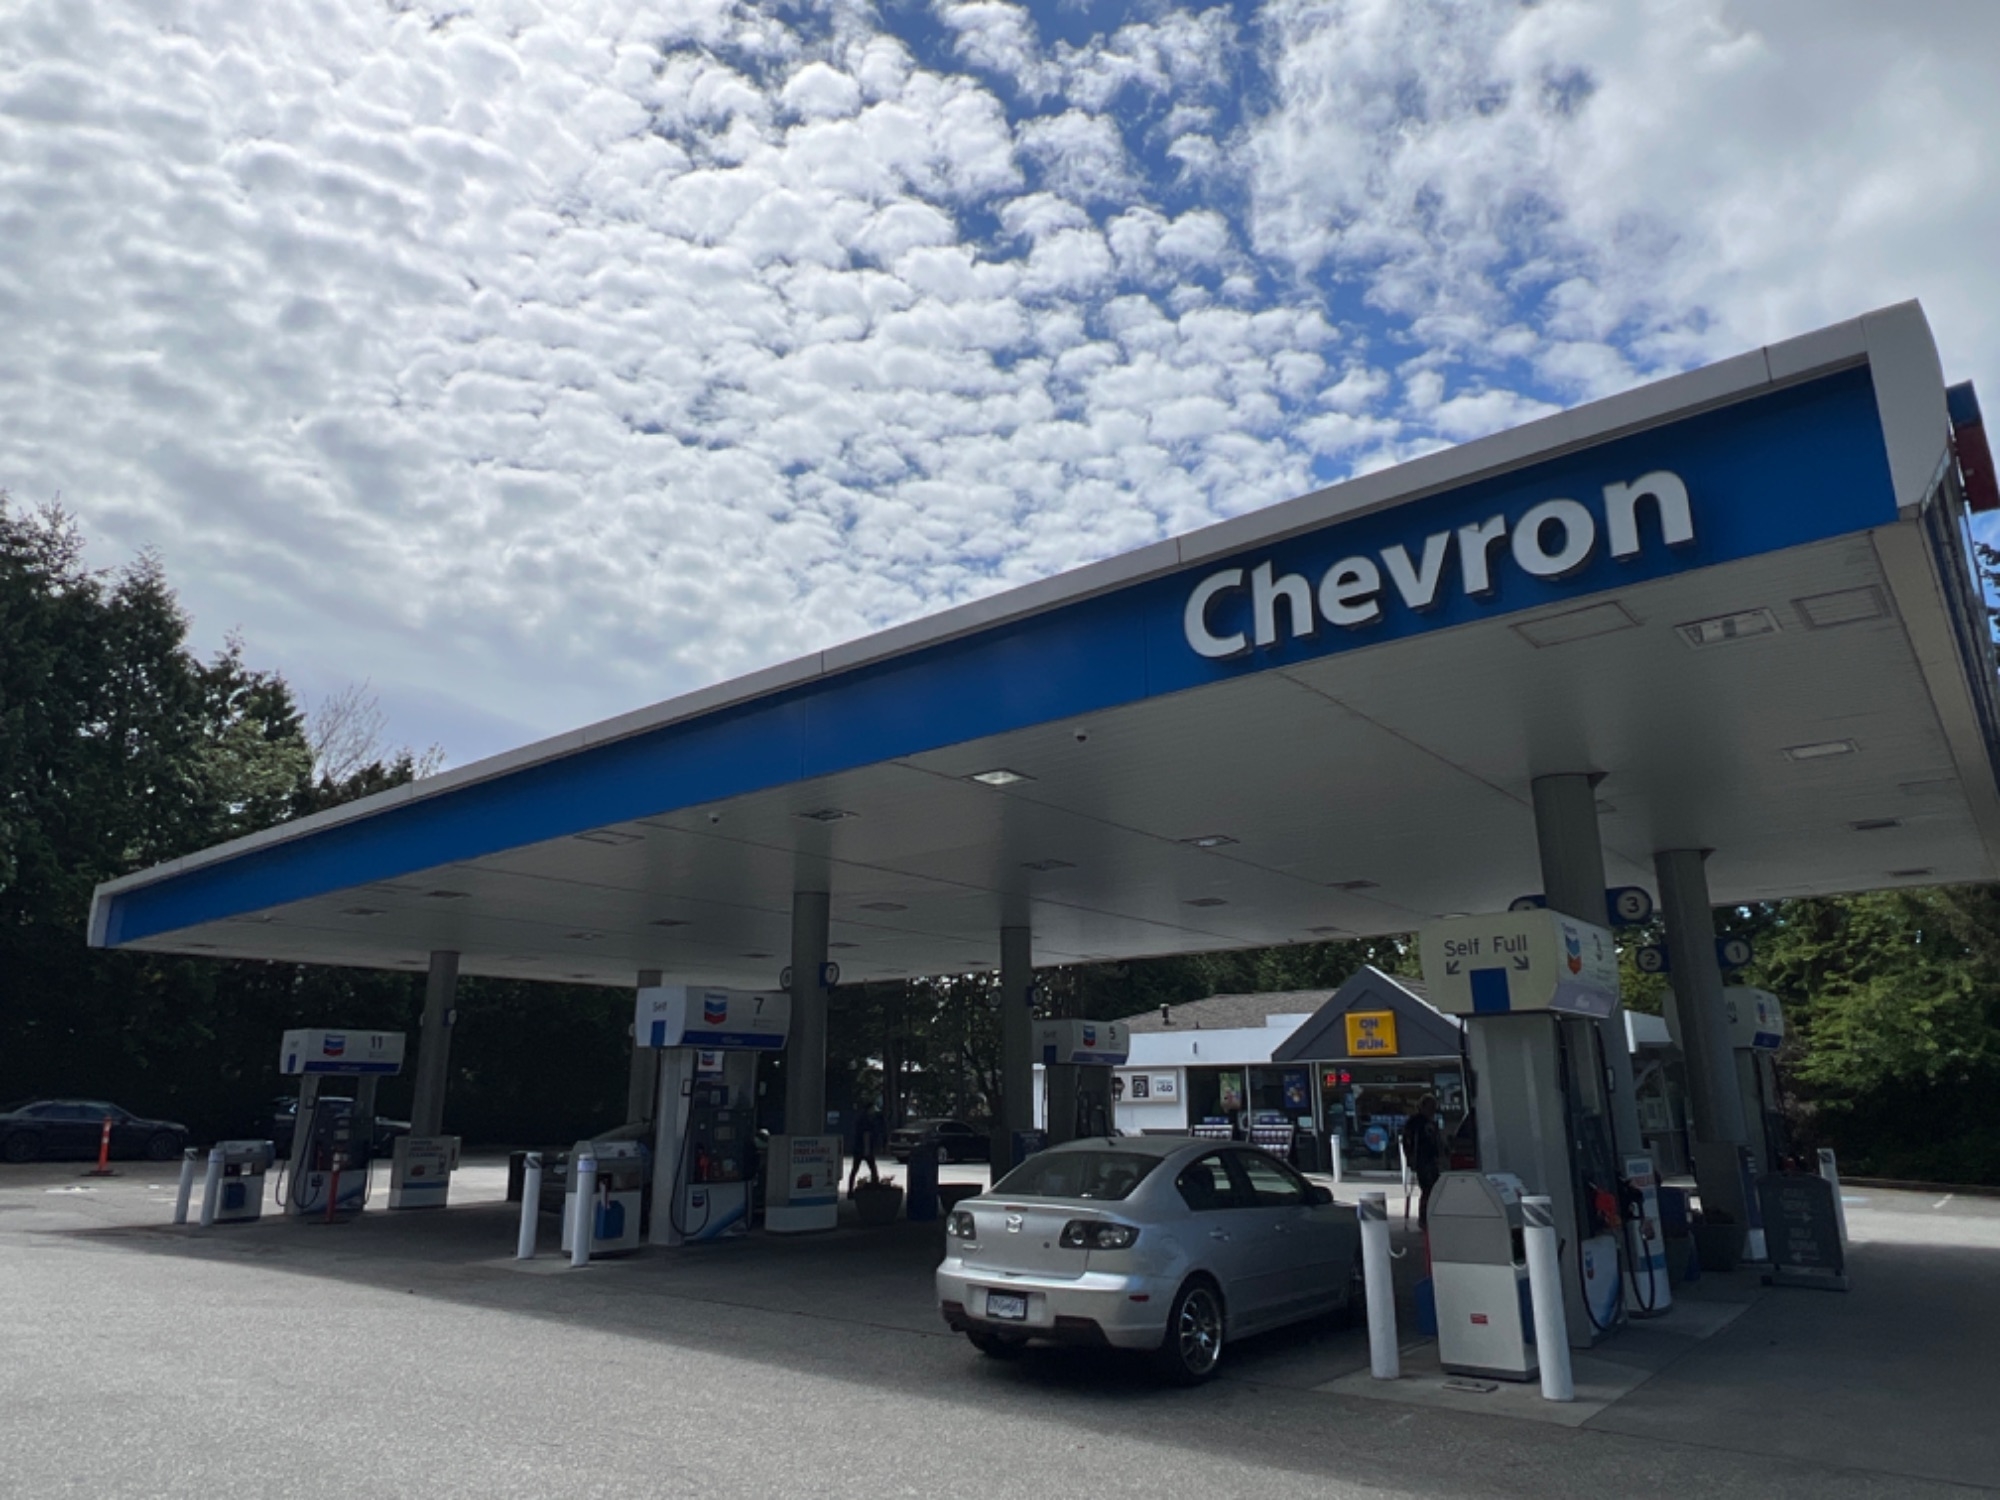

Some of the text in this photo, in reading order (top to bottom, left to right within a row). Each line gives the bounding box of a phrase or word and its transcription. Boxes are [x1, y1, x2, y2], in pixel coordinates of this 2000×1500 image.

[1183, 469, 1695, 659] Chevron
[1626, 896, 1639, 913] 3
[1444, 934, 1527, 957] Self Full
[1733, 946, 1741, 959] 1
[1644, 953, 1656, 967] 2
[753, 997, 764, 1014] 7
[1109, 1026, 1116, 1040] 5
[371, 1035, 383, 1049] 11
